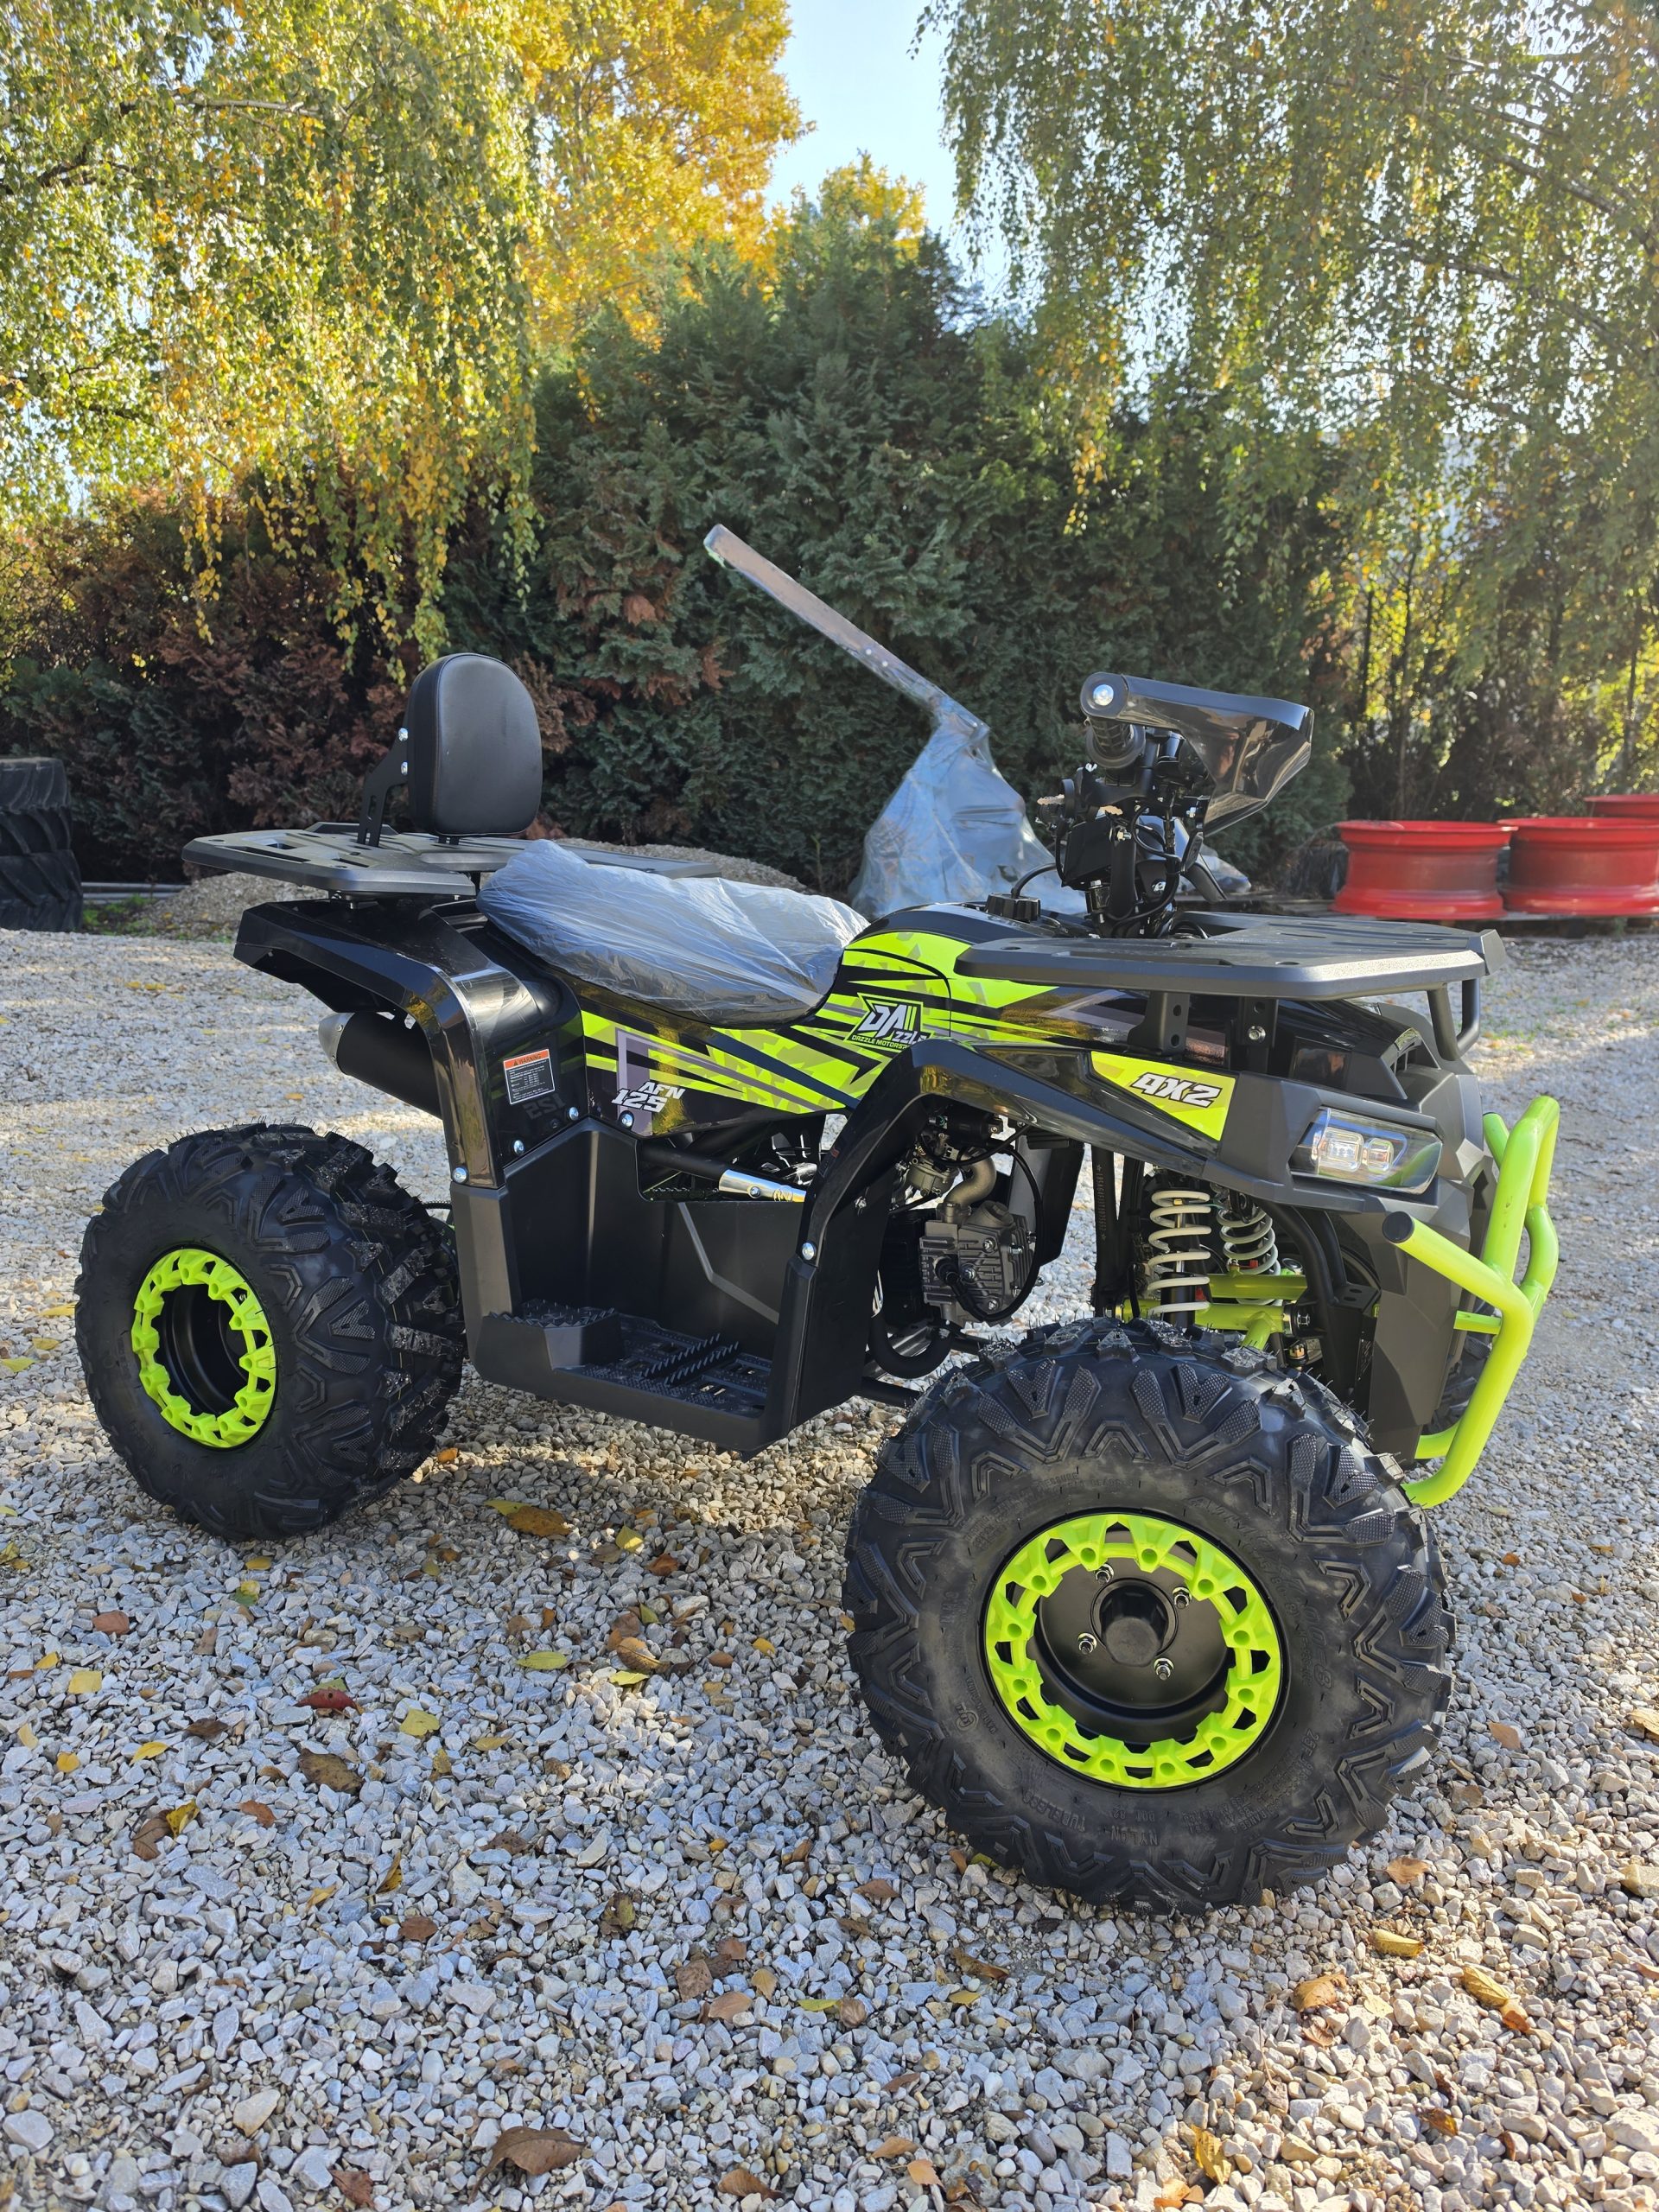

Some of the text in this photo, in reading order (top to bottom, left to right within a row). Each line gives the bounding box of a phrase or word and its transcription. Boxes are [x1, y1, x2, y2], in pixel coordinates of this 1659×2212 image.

[851, 1035, 876, 1045] DAZZLE
[612, 1088, 668, 1113] 125
[1131, 1072, 1223, 1108] 4X2
[1022, 1789, 1085, 1832] TUBELESS
[1109, 1825, 1159, 1846] NYLON
